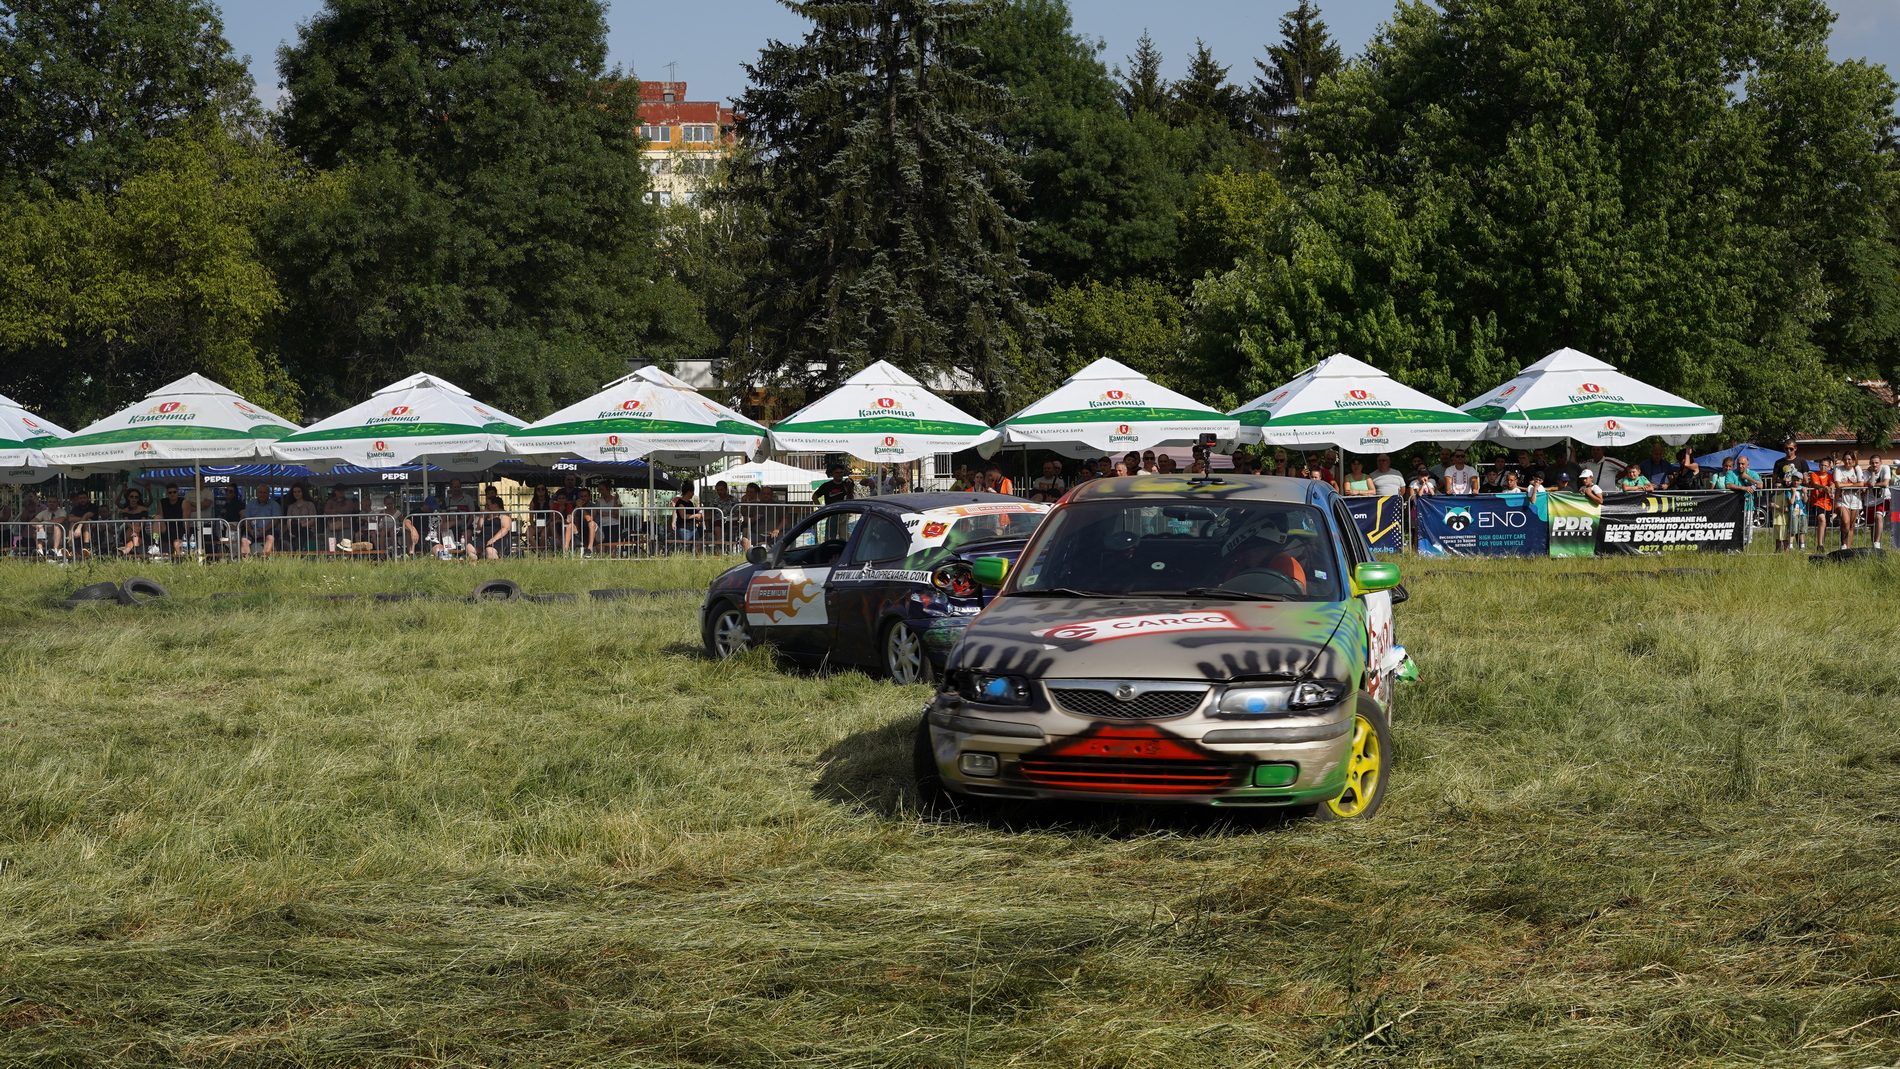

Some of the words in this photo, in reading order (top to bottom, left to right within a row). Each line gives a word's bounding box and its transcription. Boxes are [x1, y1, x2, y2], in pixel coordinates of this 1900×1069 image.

[1568, 394, 1624, 403] Каменица
[163, 403, 174, 412] К
[128, 414, 196, 424] Каменица
[366, 416, 420, 424] Каменица
[1478, 511, 1526, 528] ENO
[1553, 517, 1594, 530] PDR
[1604, 531, 1631, 542] БЕЗ
[1634, 529, 1734, 543] БОЯДИСВАНЕ
[1113, 617, 1228, 629] CARCO
